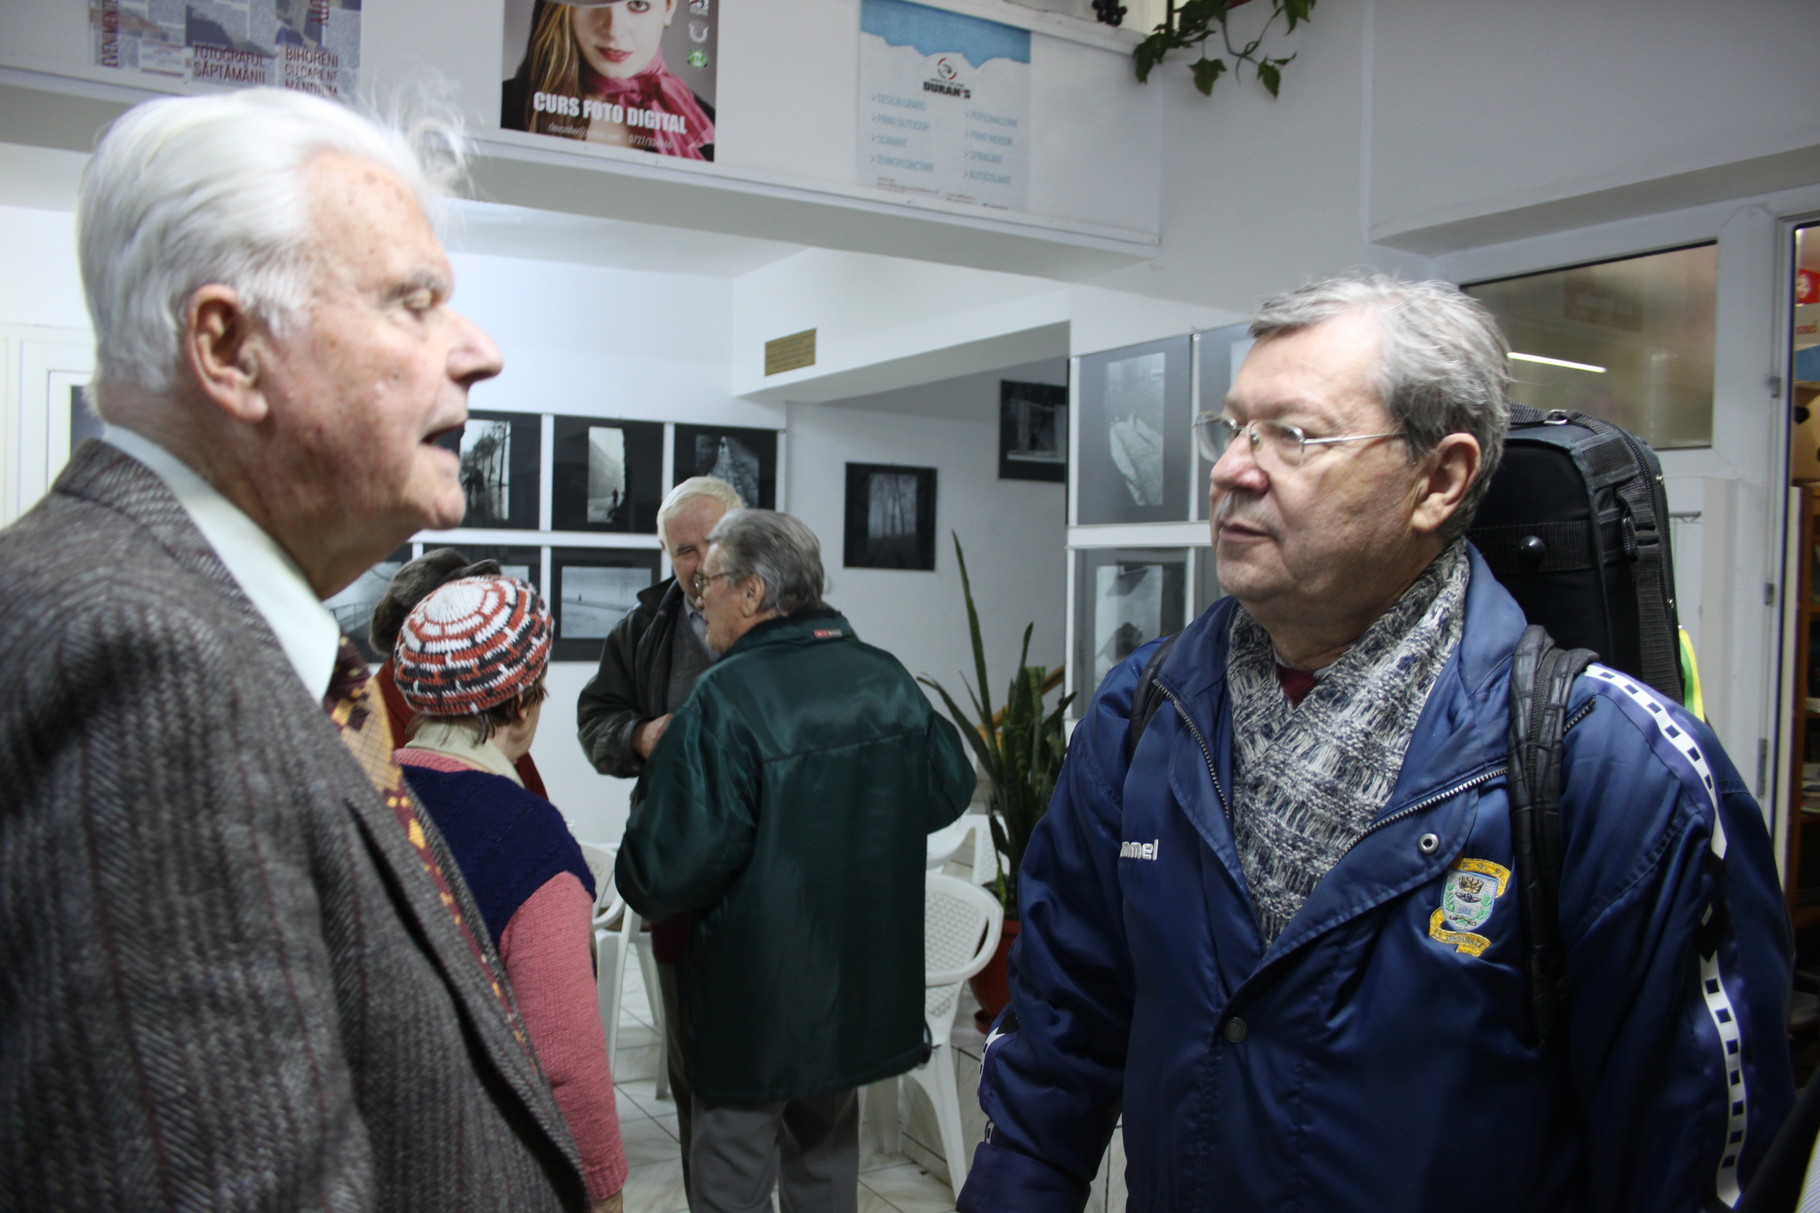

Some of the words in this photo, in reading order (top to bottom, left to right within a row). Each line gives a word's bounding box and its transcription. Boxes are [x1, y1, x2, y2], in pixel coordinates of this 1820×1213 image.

[193, 44, 265, 69] FOTOGRAFUL
[285, 46, 338, 68] BIHORENI
[533, 91, 580, 117] CURS
[582, 99, 625, 124] FOTO
[626, 106, 687, 135] DIGITAL
